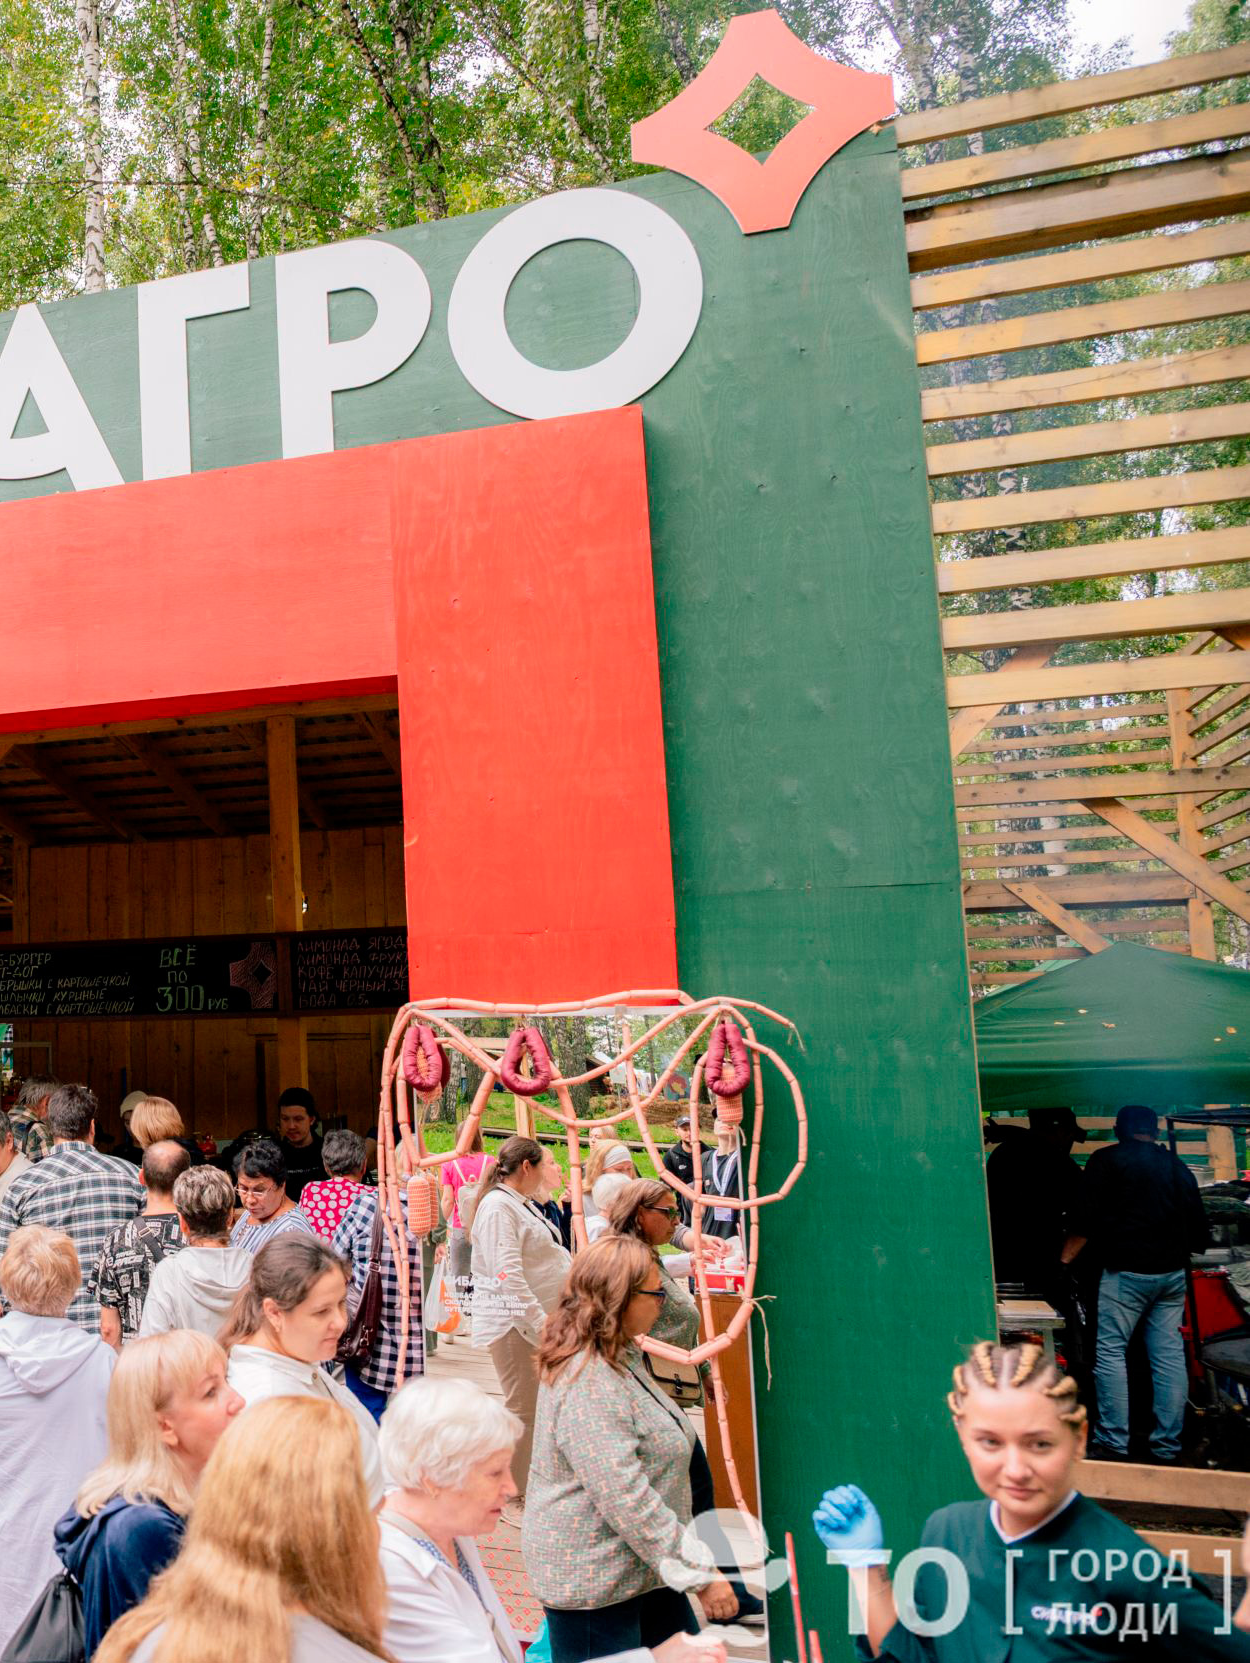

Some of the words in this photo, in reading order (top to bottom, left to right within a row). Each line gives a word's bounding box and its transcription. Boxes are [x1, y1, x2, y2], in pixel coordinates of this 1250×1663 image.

[297, 937, 361, 952] ЛИМОНАД
[158, 943, 198, 969] ВСЁ
[296, 952, 361, 966] ЛИМОНАД
[166, 969, 188, 985] ПО
[297, 965, 334, 980] КОФЕ
[47, 978, 53, 989] С
[52, 987, 108, 1003] КУРИНЫЕ
[155, 984, 205, 1013] 300
[207, 997, 230, 1011] РУБ
[46, 1003, 53, 1015] С
